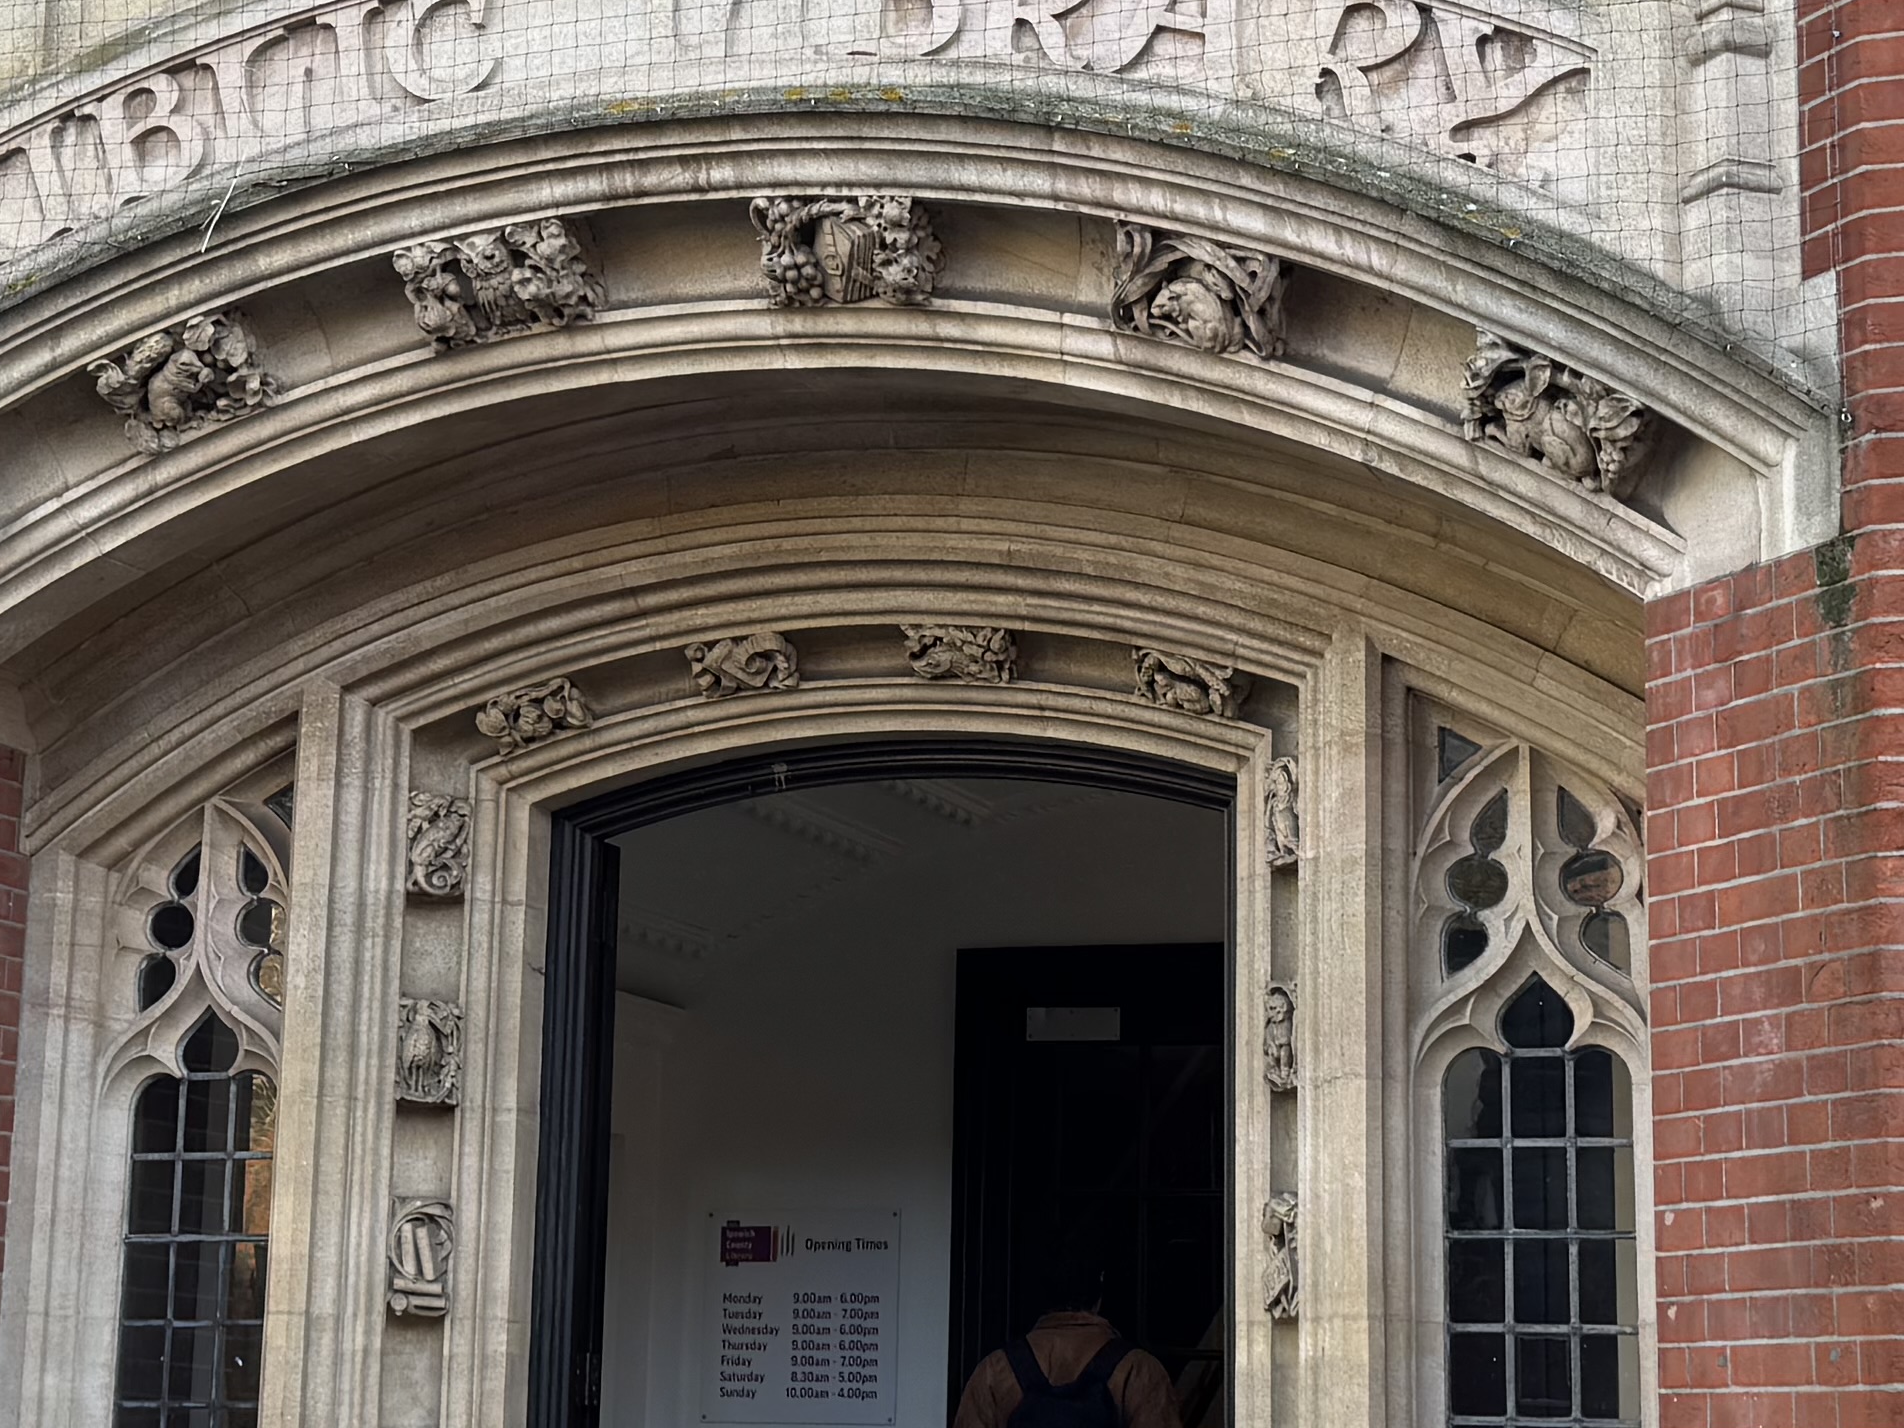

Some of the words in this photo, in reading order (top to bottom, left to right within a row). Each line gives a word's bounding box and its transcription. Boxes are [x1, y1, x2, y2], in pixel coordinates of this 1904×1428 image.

[805, 1238, 852, 1252] Opening
[855, 1237, 888, 1251] Times
[722, 1292, 764, 1305] Monday
[722, 1308, 764, 1320] Tuesday
[722, 1324, 780, 1336] Wednesday
[722, 1340, 768, 1352] Thursday
[721, 1356, 752, 1368] Friday
[720, 1372, 765, 1384] Saturday
[720, 1387, 757, 1400] Sunday
